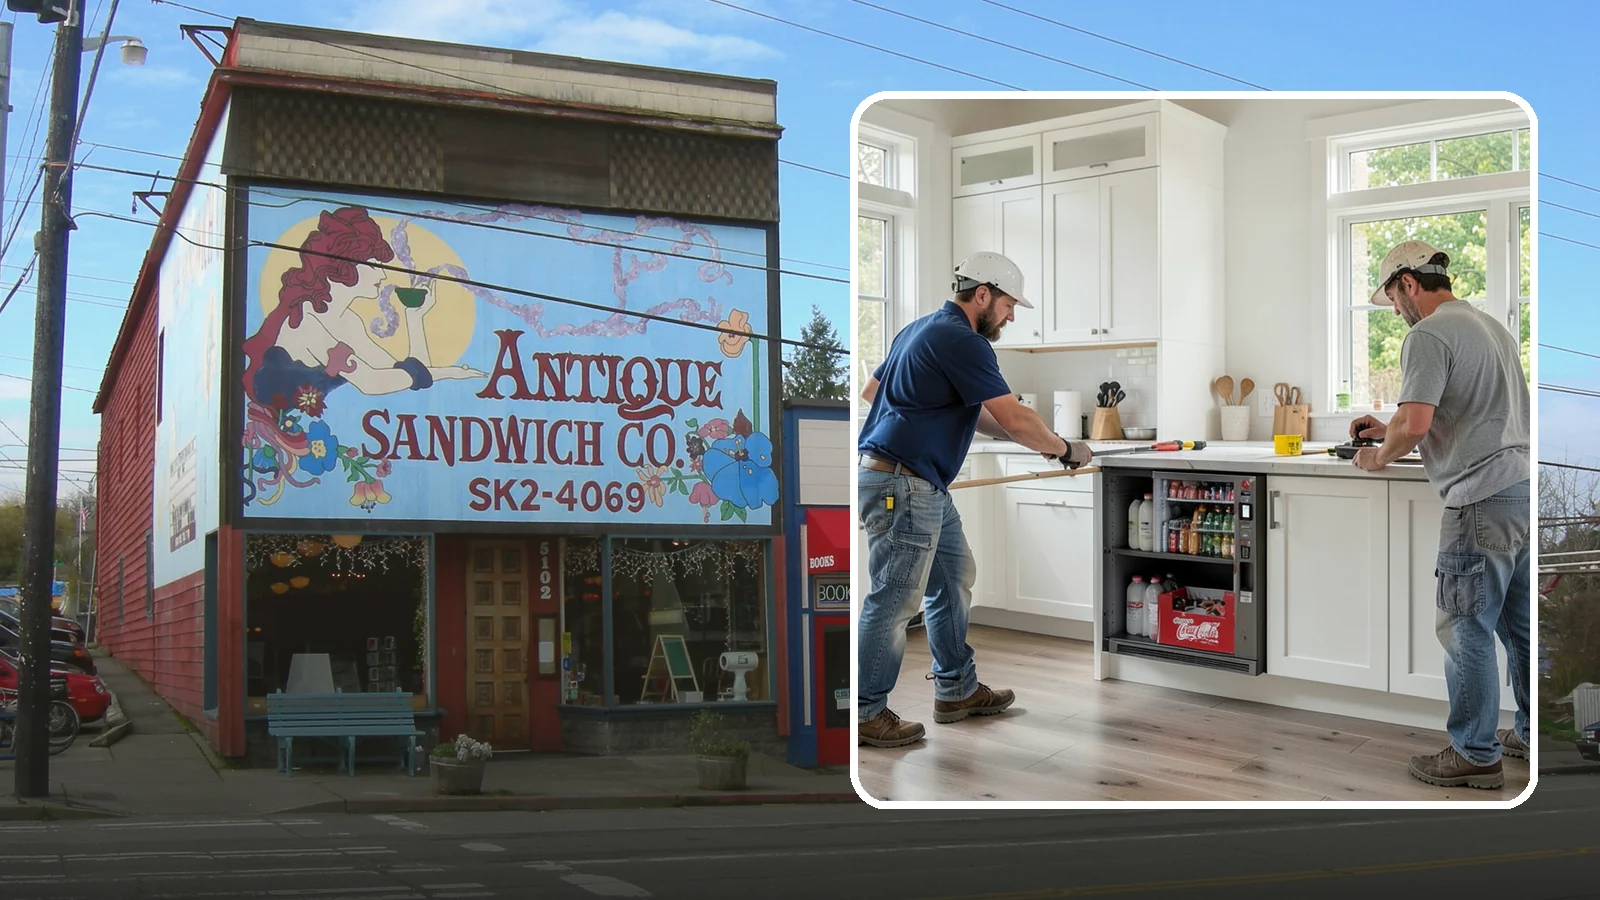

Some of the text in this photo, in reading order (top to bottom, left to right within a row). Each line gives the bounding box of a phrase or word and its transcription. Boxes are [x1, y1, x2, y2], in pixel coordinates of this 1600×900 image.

[476, 329, 724, 420] ANTIQUE
[361, 409, 685, 468] SANDWICH CO.
[468, 477, 646, 512] SK2-4069
[539, 541, 552, 600] 5102
[809, 555, 835, 569] BOOKS
